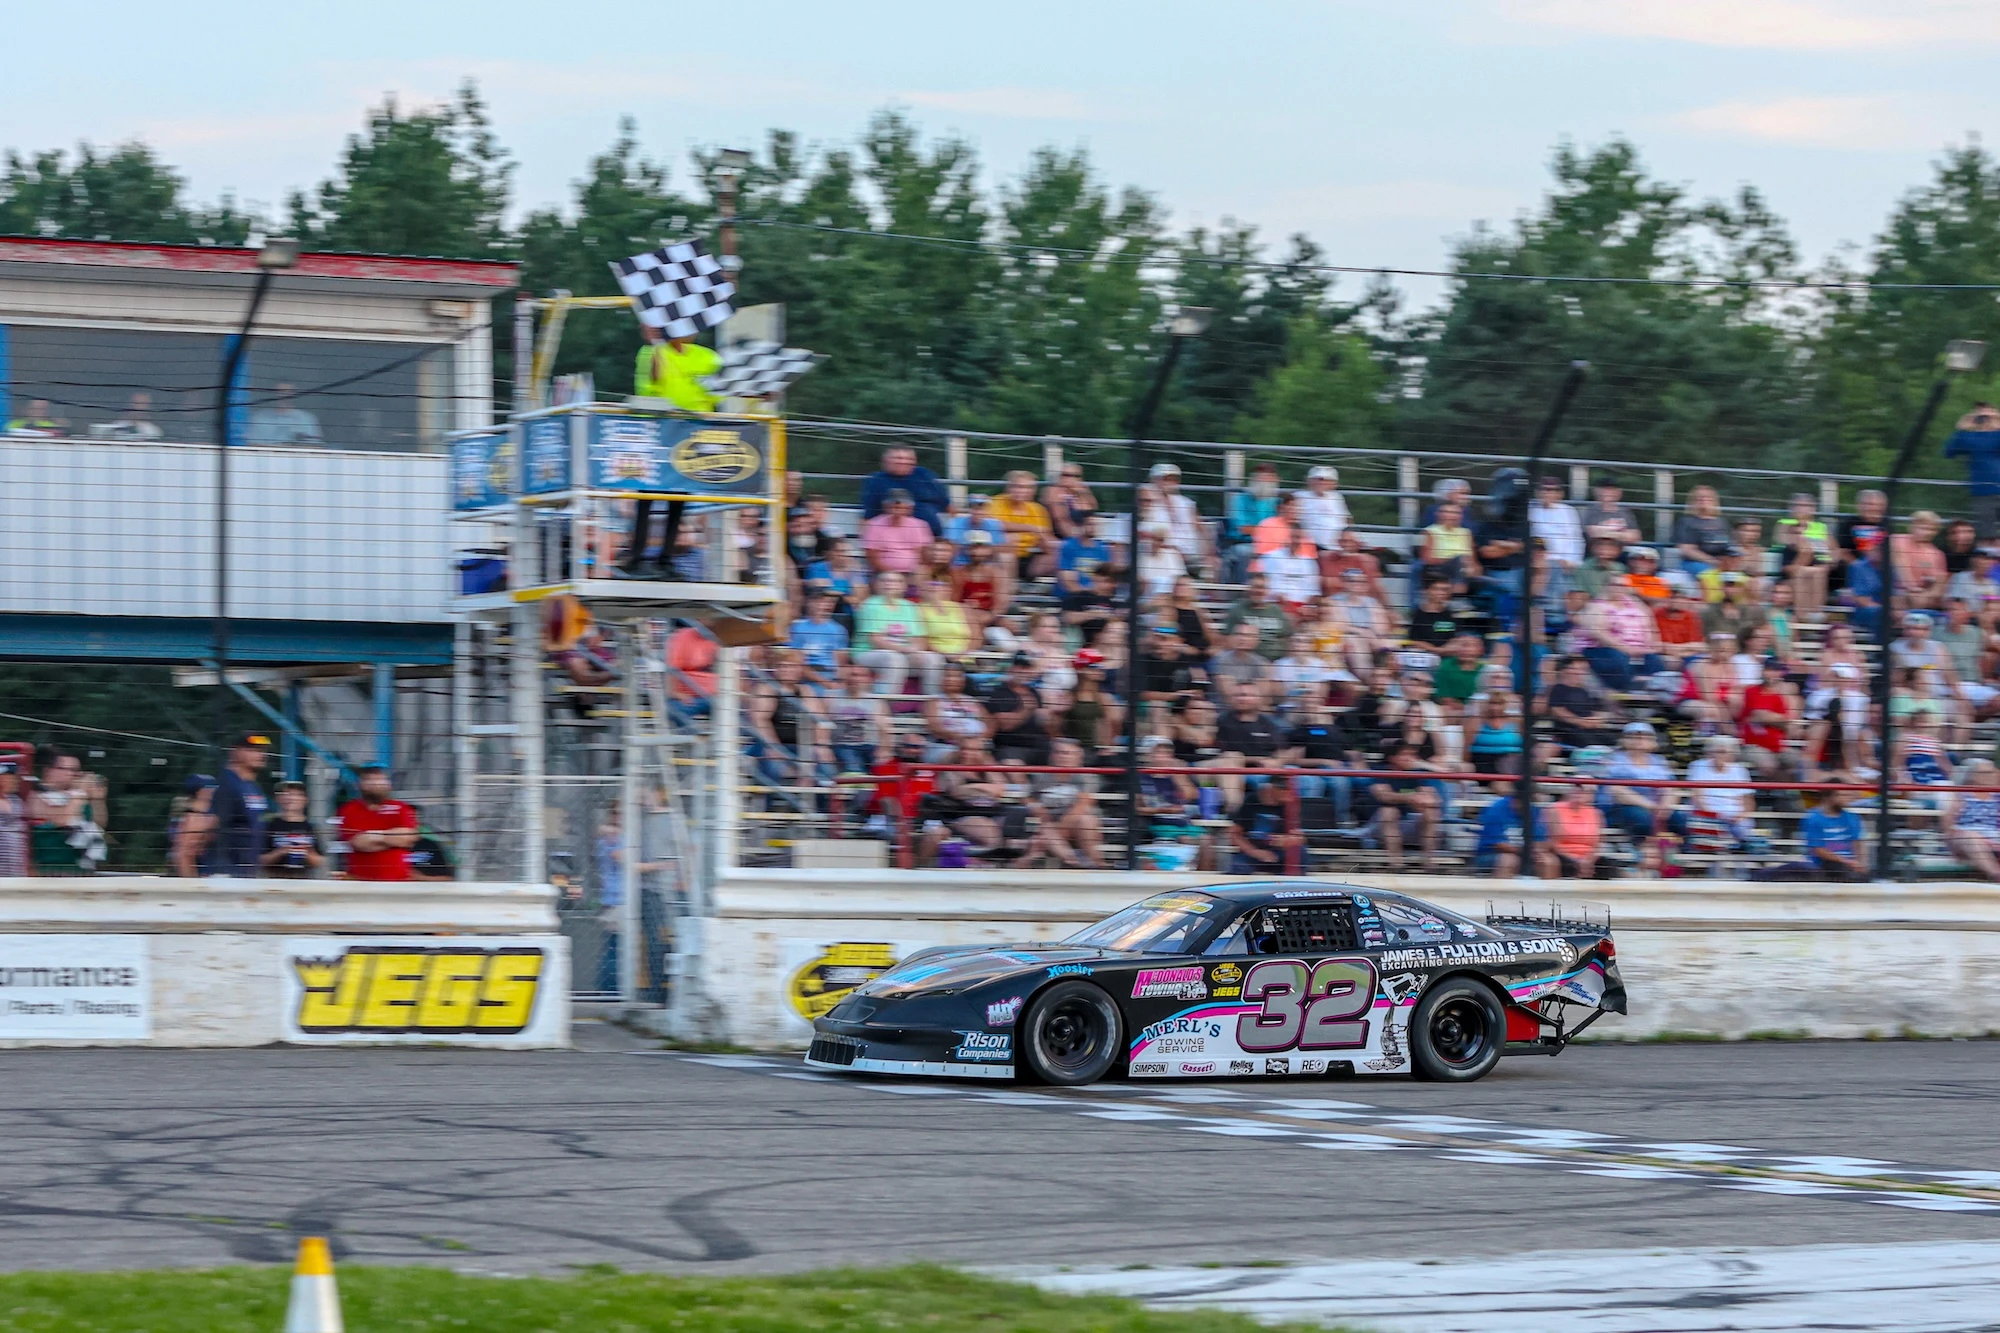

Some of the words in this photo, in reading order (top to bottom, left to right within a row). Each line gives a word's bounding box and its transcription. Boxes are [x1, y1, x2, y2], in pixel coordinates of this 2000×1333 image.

[1381, 950, 1425, 963] JAMES
[1428, 948, 1440, 960] E.
[1439, 941, 1502, 958] FULTON
[1508, 941, 1519, 953] &
[1523, 937, 1567, 954] SONS
[1381, 959, 1443, 971] EXCAVATING
[1448, 954, 1516, 966] CONTRACTORS
[1046, 962, 1096, 979] Hoosier
[294, 946, 544, 1034] JEGS
[1140, 982, 1183, 996] TOWING
[1212, 986, 1241, 997] JEGS
[1235, 957, 1379, 1052] 32
[1144, 1019, 1221, 1042] MERL'S
[963, 1032, 1009, 1048] Rison
[1159, 1038, 1205, 1046] TOWING
[957, 1047, 1010, 1060] Companies
[1133, 1064, 1166, 1073] SIMPSON
[1182, 1064, 1213, 1073] Bassett
[1230, 1060, 1254, 1068] Holley
